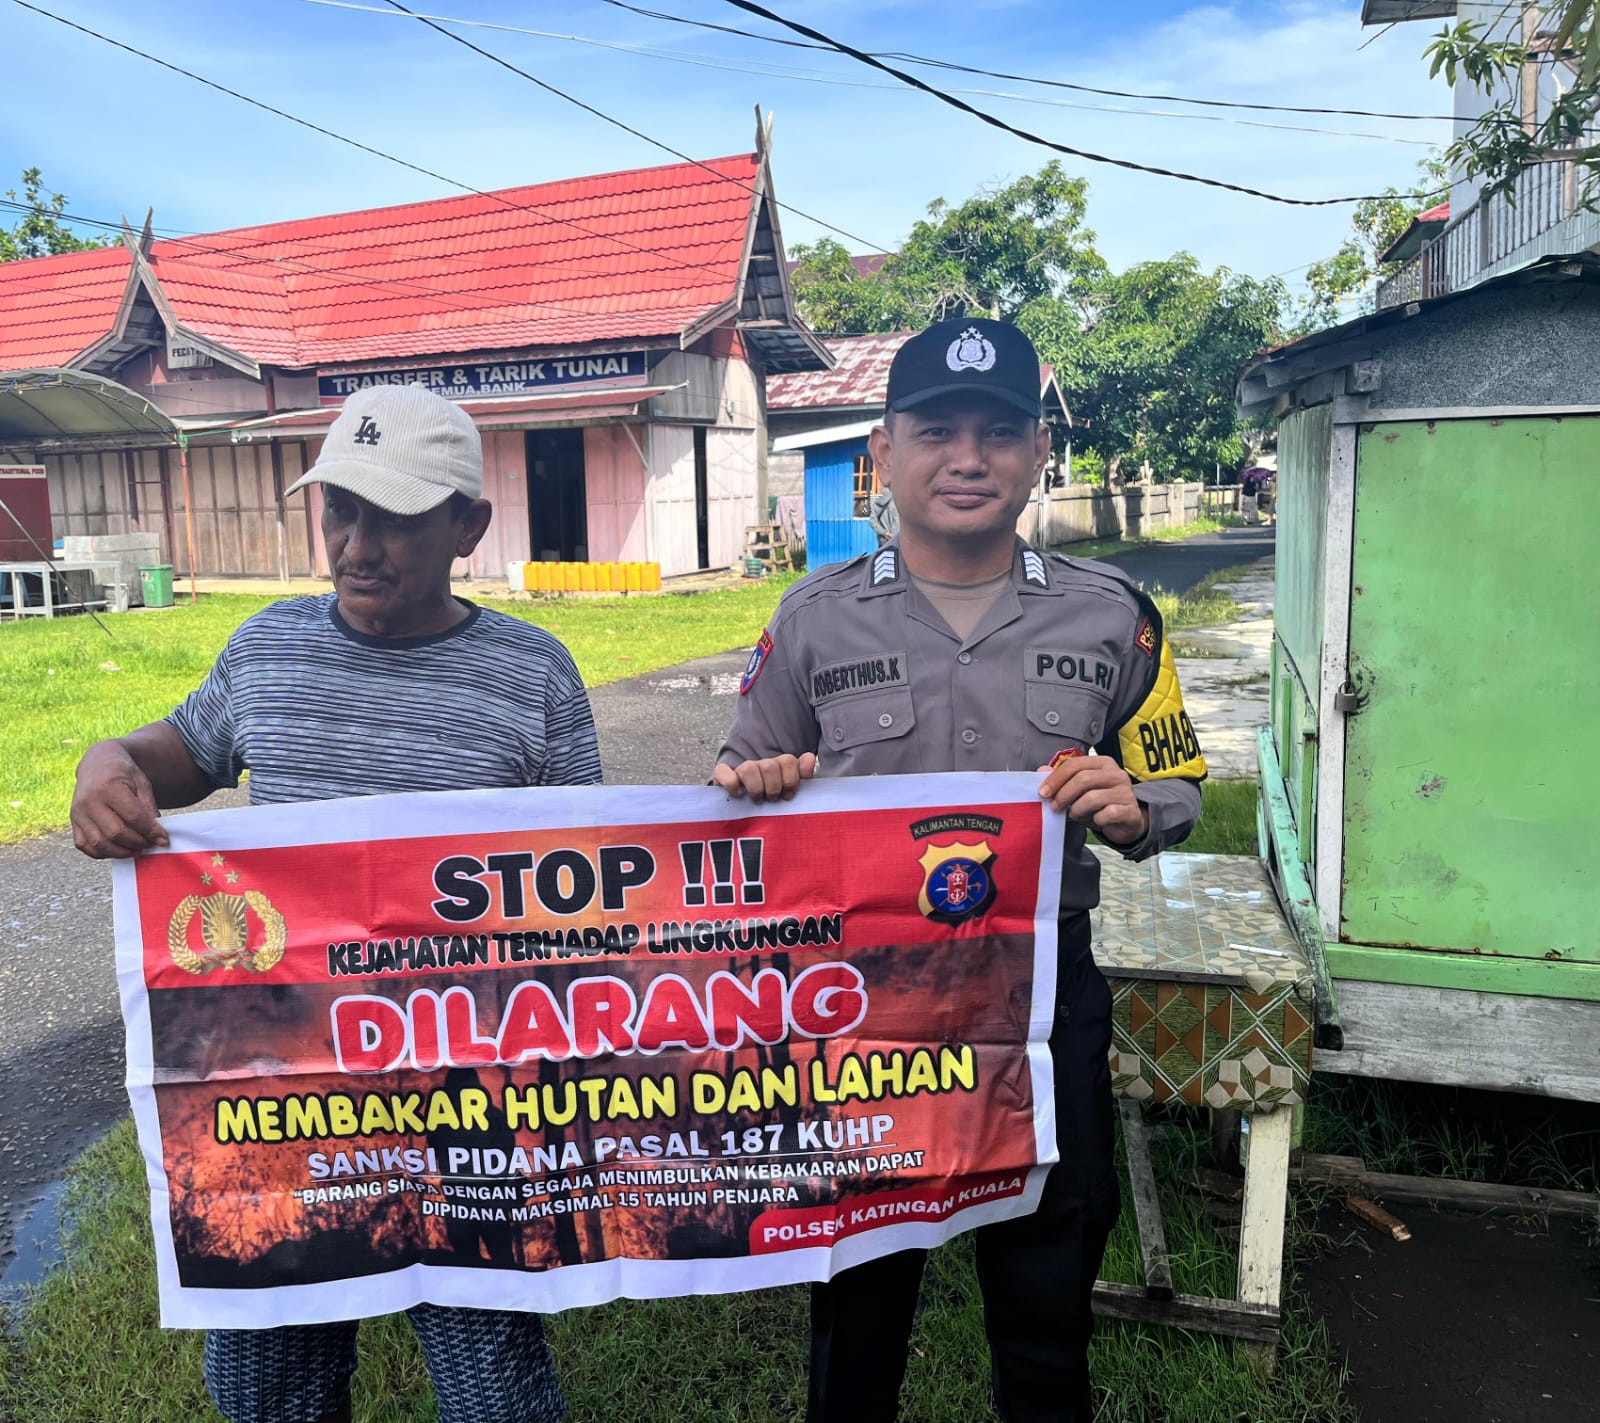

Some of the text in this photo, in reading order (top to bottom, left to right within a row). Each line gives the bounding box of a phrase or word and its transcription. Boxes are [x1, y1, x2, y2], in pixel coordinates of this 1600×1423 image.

[332, 357, 629, 393] TRANSFER & TARIK TUNAI
[427, 382, 526, 396] EMUA BANK
[353, 416, 381, 445] LA
[814, 657, 900, 699] ROBERTHUS.K
[1037, 654, 1114, 691] POLRI
[914, 818, 1000, 837] KALIMANTAN TENGAH
[432, 838, 764, 922] STOP !!!
[328, 912, 842, 977] KEJAHATAN TERHADAP LINGKUNGAN
[330, 962, 868, 1074] DILARANG
[216, 1044, 976, 1143] MEMBAKAR HUTAN DAN LAHAN
[307, 1114, 894, 1178] SANKSI PIDANA PASAL 187 KUHP
[387, 1180, 438, 1196] SIAPA
[443, 1184, 516, 1201] DENGAN
[521, 1174, 594, 1198] SEGAJA
[599, 1165, 738, 1187] MENIMBULKAN
[744, 1157, 861, 1180] KEBAKARAN
[866, 1151, 924, 1173] DAPAT
[422, 1186, 799, 1223] DIPIDANA MAKSIMAL 15 TAHUN PENJARA
[763, 1176, 1022, 1244] POLSEK KATINGAN KUALA
